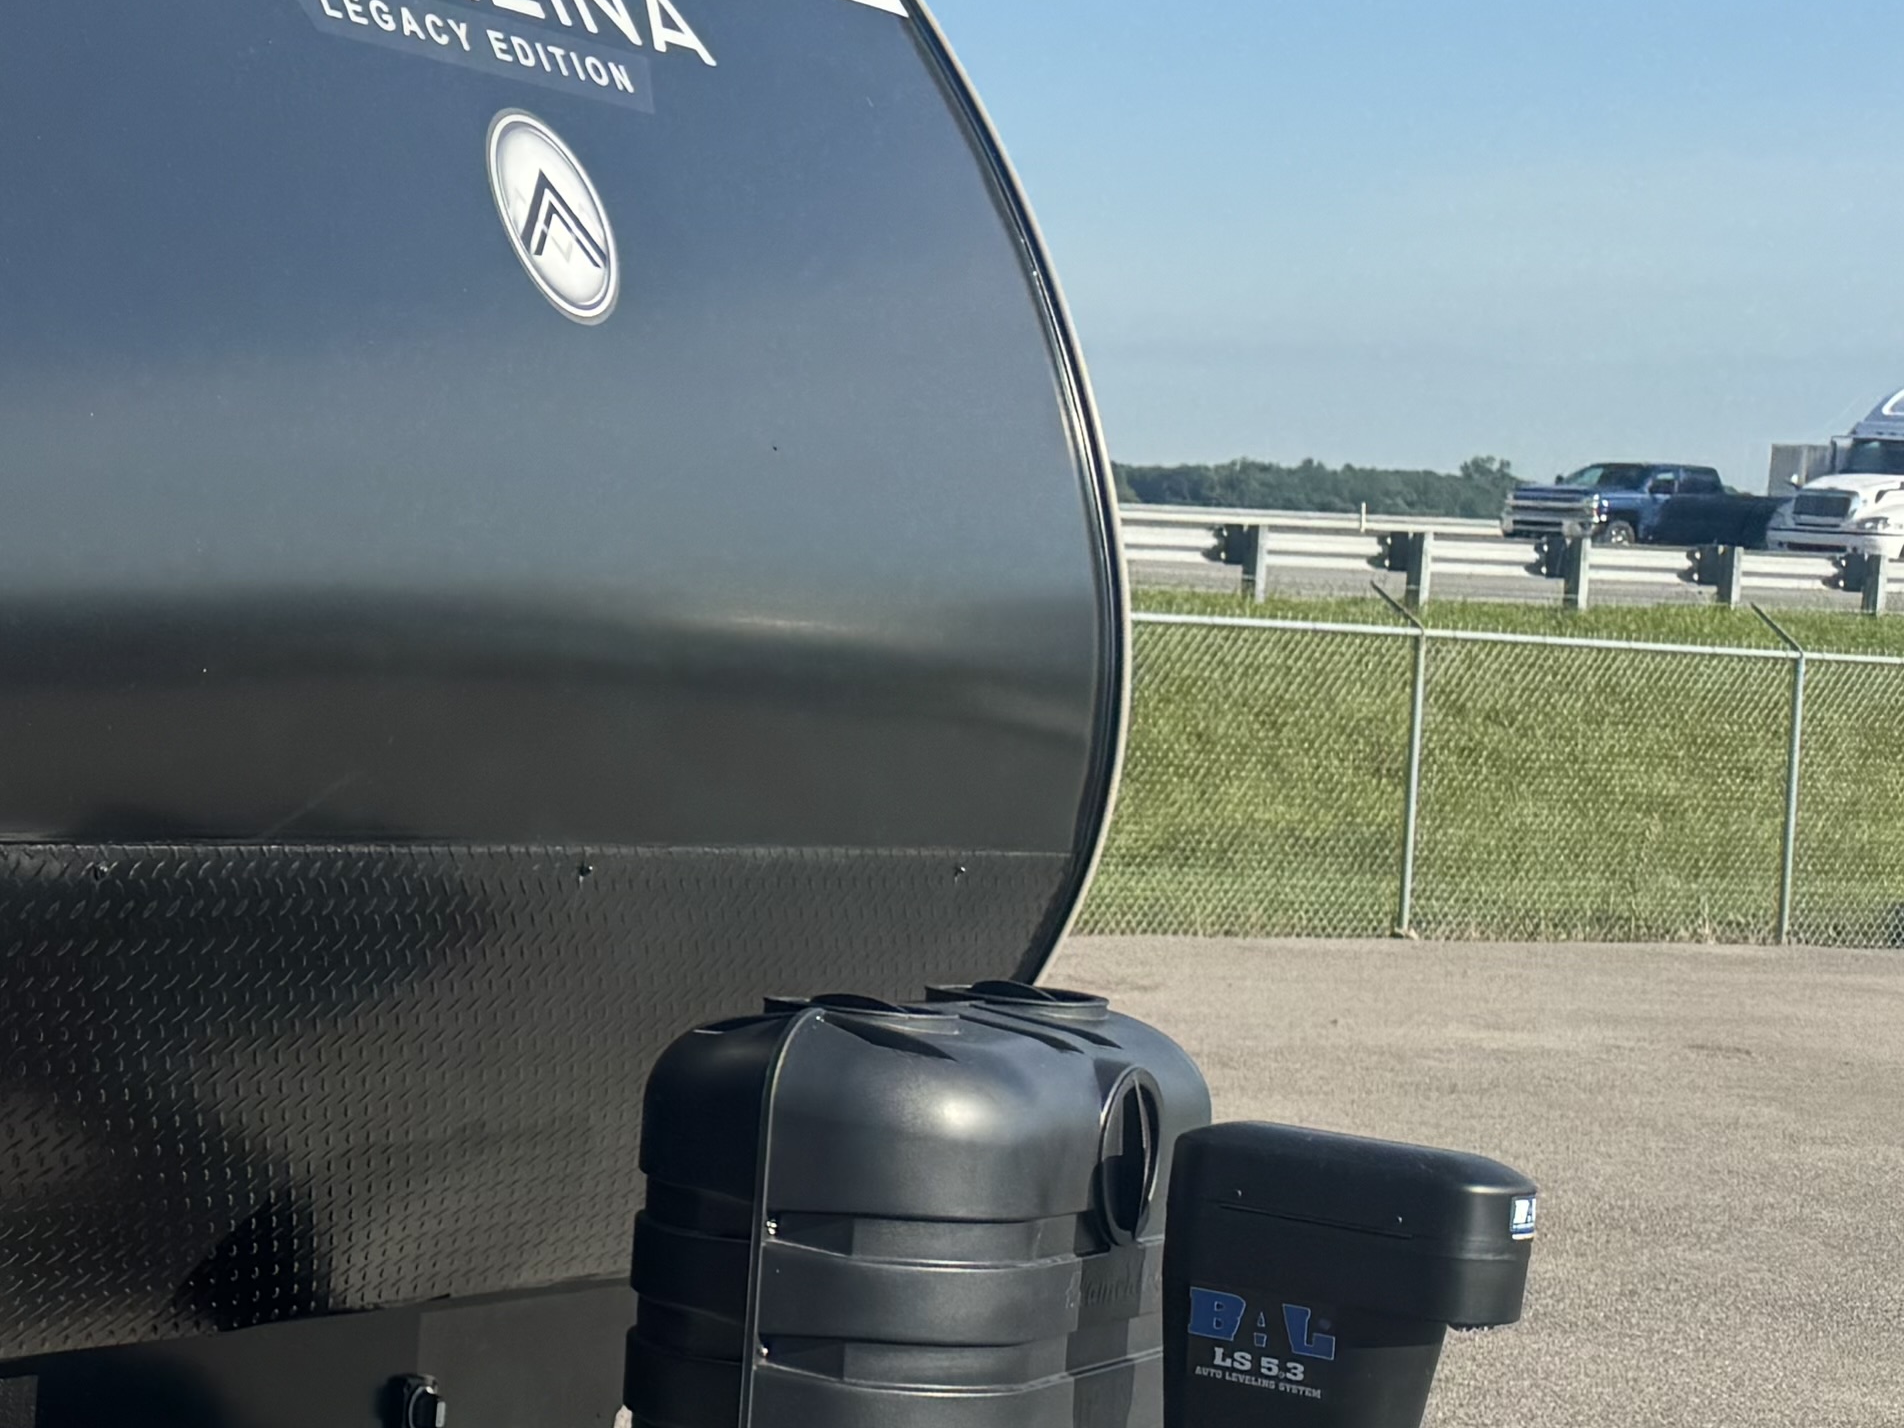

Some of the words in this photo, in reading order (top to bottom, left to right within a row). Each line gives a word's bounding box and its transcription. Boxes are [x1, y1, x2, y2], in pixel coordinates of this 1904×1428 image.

[486, 29, 635, 94] EDITION
[1187, 1286, 1336, 1361] BAL
[1195, 1365, 1223, 1380] AUTO
[1225, 1371, 1276, 1390] LEVELING
[1278, 1381, 1322, 1399] SYSTEM
[1213, 1346, 1252, 1371] LS
[1260, 1356, 1305, 1382] 5.3
